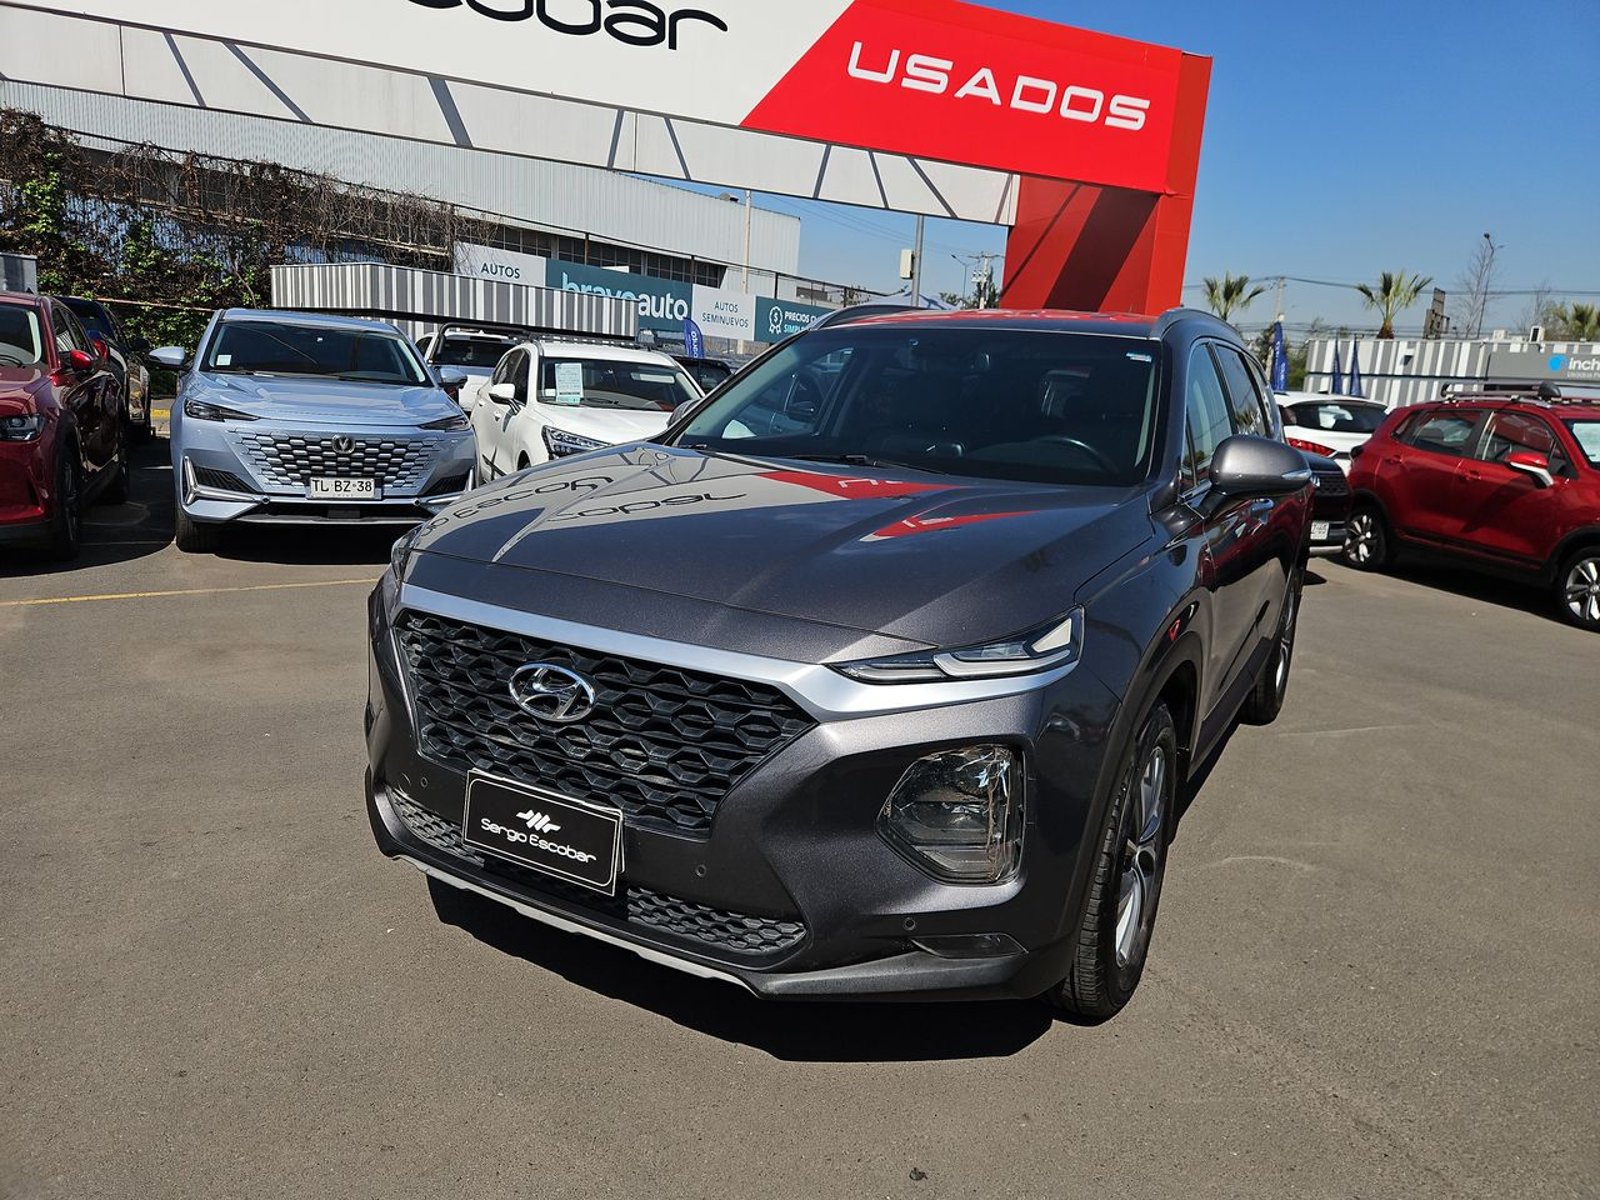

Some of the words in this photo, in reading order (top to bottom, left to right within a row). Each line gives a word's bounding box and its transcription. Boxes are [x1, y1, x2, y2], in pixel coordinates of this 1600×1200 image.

[848, 41, 1150, 131] USADOS
[481, 263, 520, 279] AUTOS
[714, 301, 739, 314] AUTOS
[701, 312, 749, 329] SEMINUEVOS
[784, 310, 810, 324] PRECIOS
[312, 479, 329, 492] TL
[334, 480, 351, 492] BZ
[357, 480, 372, 492] 38
[480, 818, 527, 843] Sergo
[529, 834, 597, 864] Escobar
